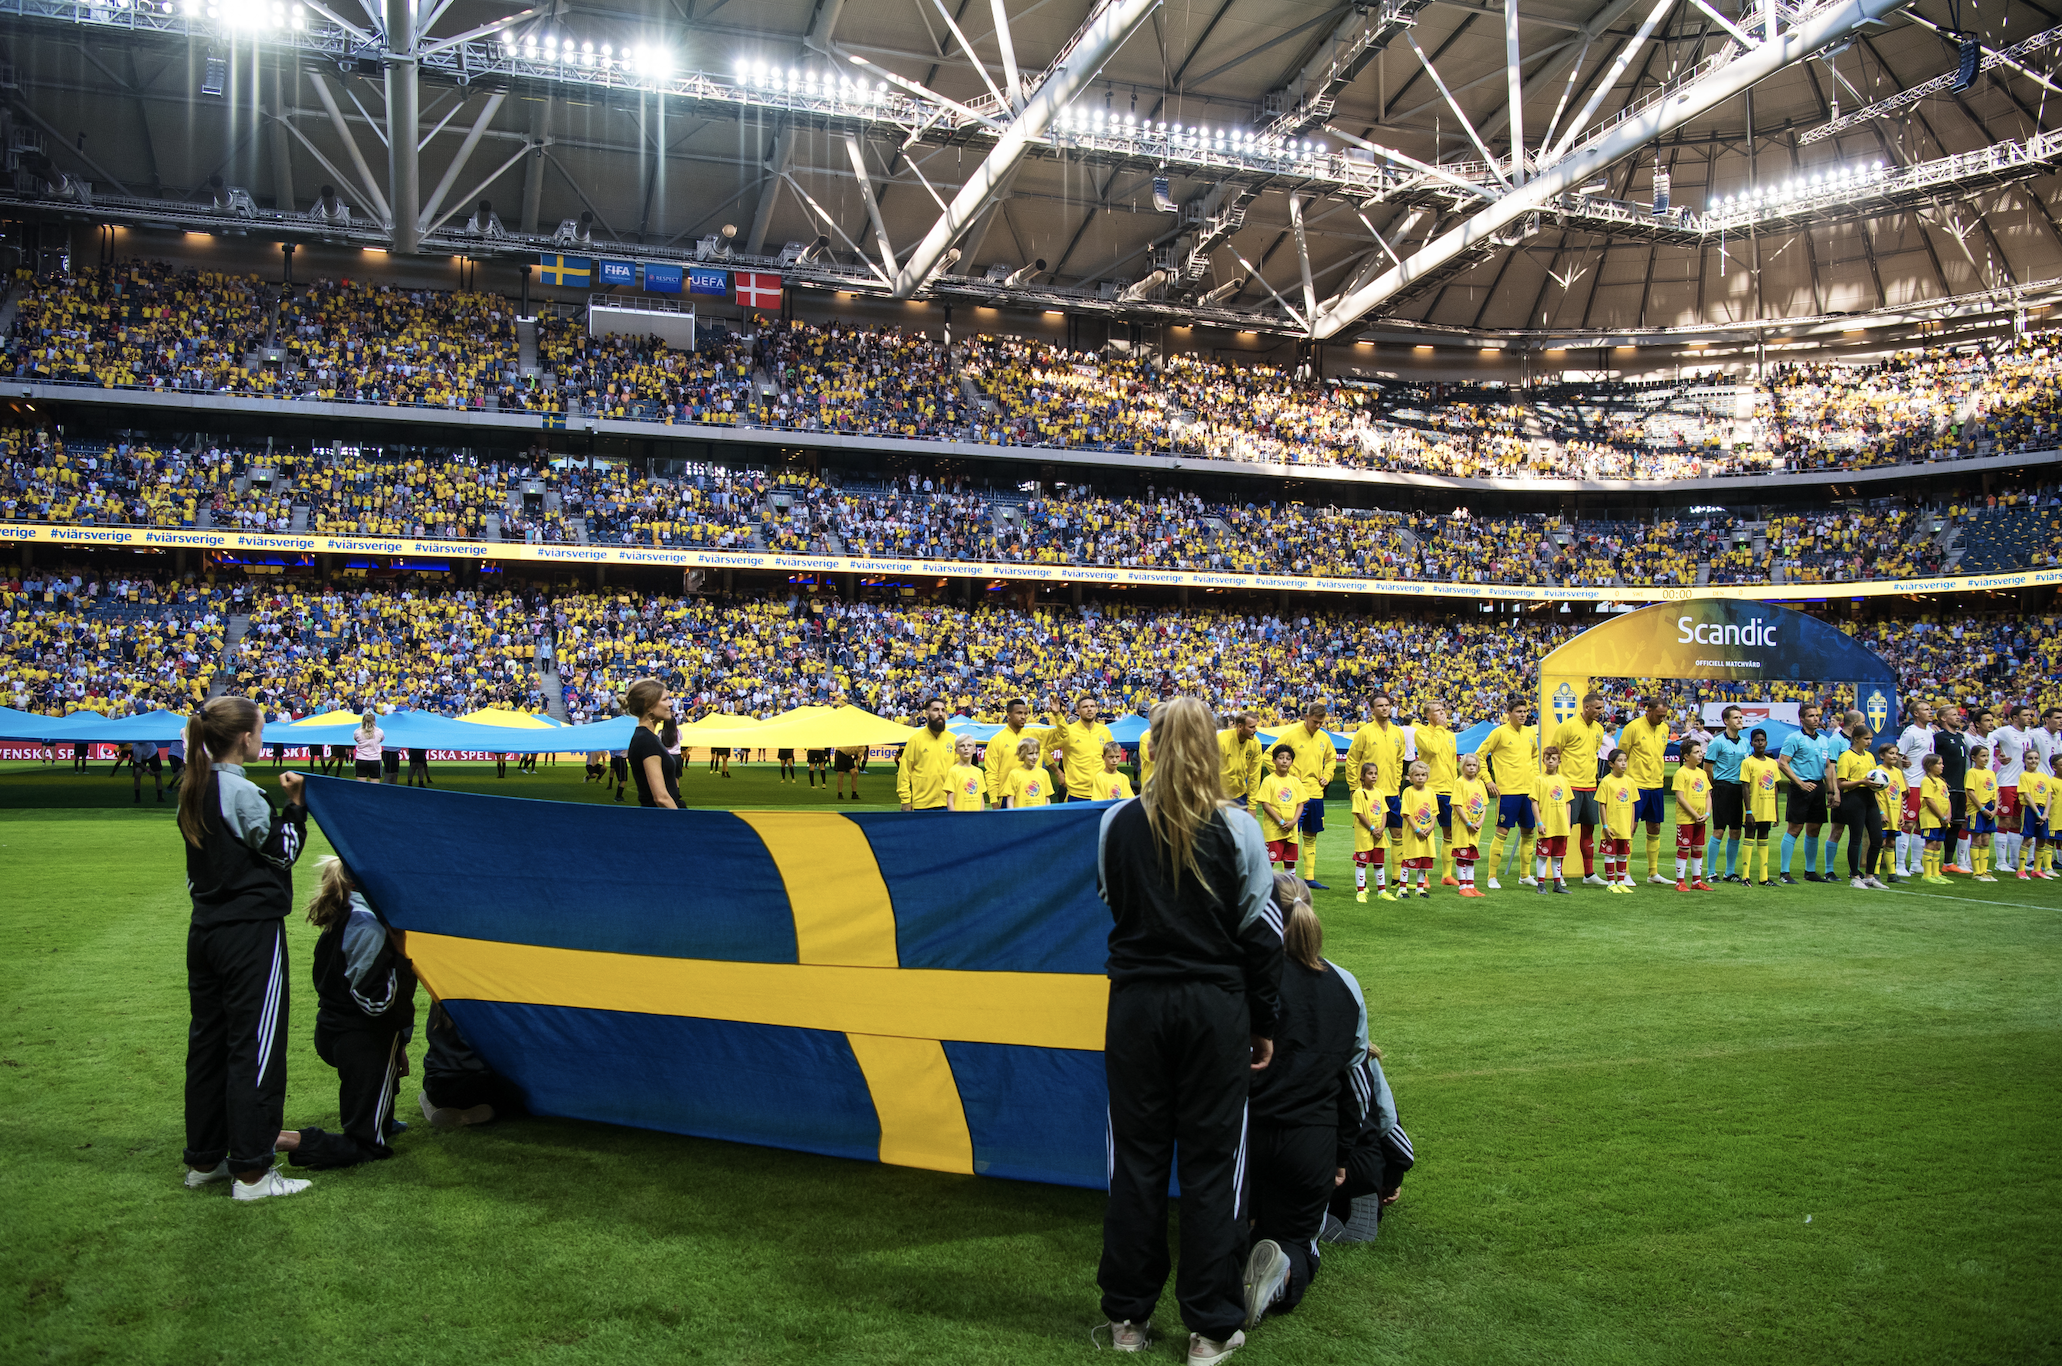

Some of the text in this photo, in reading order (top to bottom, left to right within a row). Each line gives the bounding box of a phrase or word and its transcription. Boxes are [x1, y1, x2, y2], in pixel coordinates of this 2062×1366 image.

[605, 264, 631, 276] FIFA
[655, 275, 679, 283] RESPECT
[691, 275, 725, 288] UEFA
[51, 529, 131, 543] #viärsverige
[146, 532, 225, 546] #viärsverige
[238, 536, 314, 550] #viärsverige
[328, 540, 401, 553] #viärsverige
[415, 543, 486, 556] #viärsverige
[538, 548, 607, 562] #viärsverige
[619, 551, 686, 564] #viärsverige
[698, 555, 763, 567] #viärsverige
[775, 558, 839, 570] #viärsverige
[850, 561, 912, 573] #viärsverige
[923, 564, 983, 576] #viärsverige
[993, 567, 1051, 579] #viärsverige
[1062, 570, 1118, 582] #viärsverige
[1128, 573, 1183, 584] #viärsverige
[1193, 575, 1246, 587] #viärsverige
[1256, 578, 1307, 589] #viärsverige
[1317, 581, 1367, 593] #viärsverige
[1376, 583, 1424, 595] #viärsverige
[1433, 586, 1481, 597] #viärsverige
[1489, 588, 1535, 599] #viärsverige
[1544, 588, 1600, 600] #viärsverige
[1893, 580, 1956, 593] #viärsverige
[1967, 576, 2026, 589] #viärsverige
[1662, 589, 1692, 599] 00:00
[1677, 616, 1777, 647] Scandic
[0, 748, 53, 759] ENSKA
[460, 751, 492, 760] SPEL
